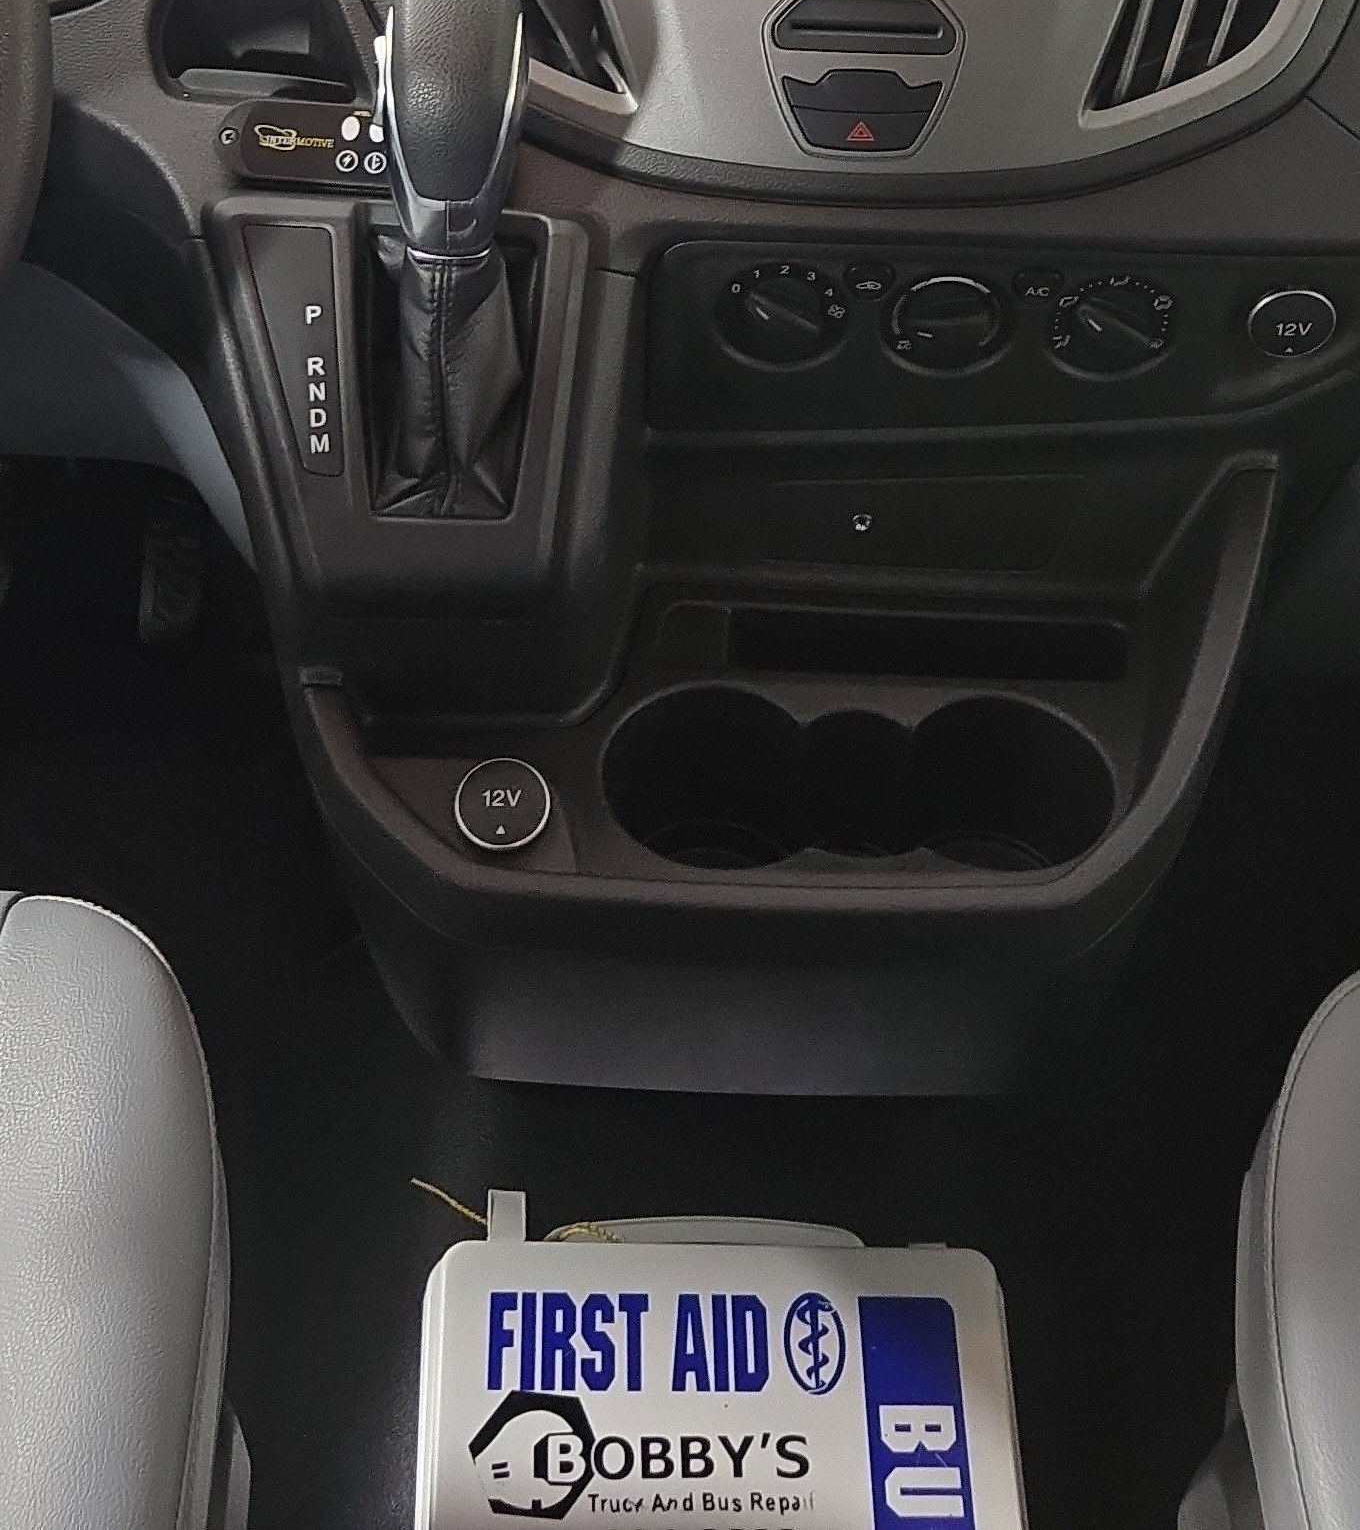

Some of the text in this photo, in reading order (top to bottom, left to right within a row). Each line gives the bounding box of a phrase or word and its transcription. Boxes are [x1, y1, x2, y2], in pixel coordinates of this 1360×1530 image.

[753, 270, 760, 279] 1
[780, 265, 790, 274] 2
[807, 271, 816, 281] 3
[824, 287, 833, 296] 4
[305, 305, 321, 324] P
[1275, 322, 1313, 336] 12V
[307, 356, 325, 375] R
[310, 382, 326, 401] N
[310, 408, 327, 428] D
[310, 433, 330, 454] M
[482, 789, 522, 807] 12V
[487, 1291, 770, 1393] FIRST AID
[547, 1433, 811, 1484] BOBBY'S
[651, 1492, 694, 1513] And
[703, 1492, 743, 1513] Bus
